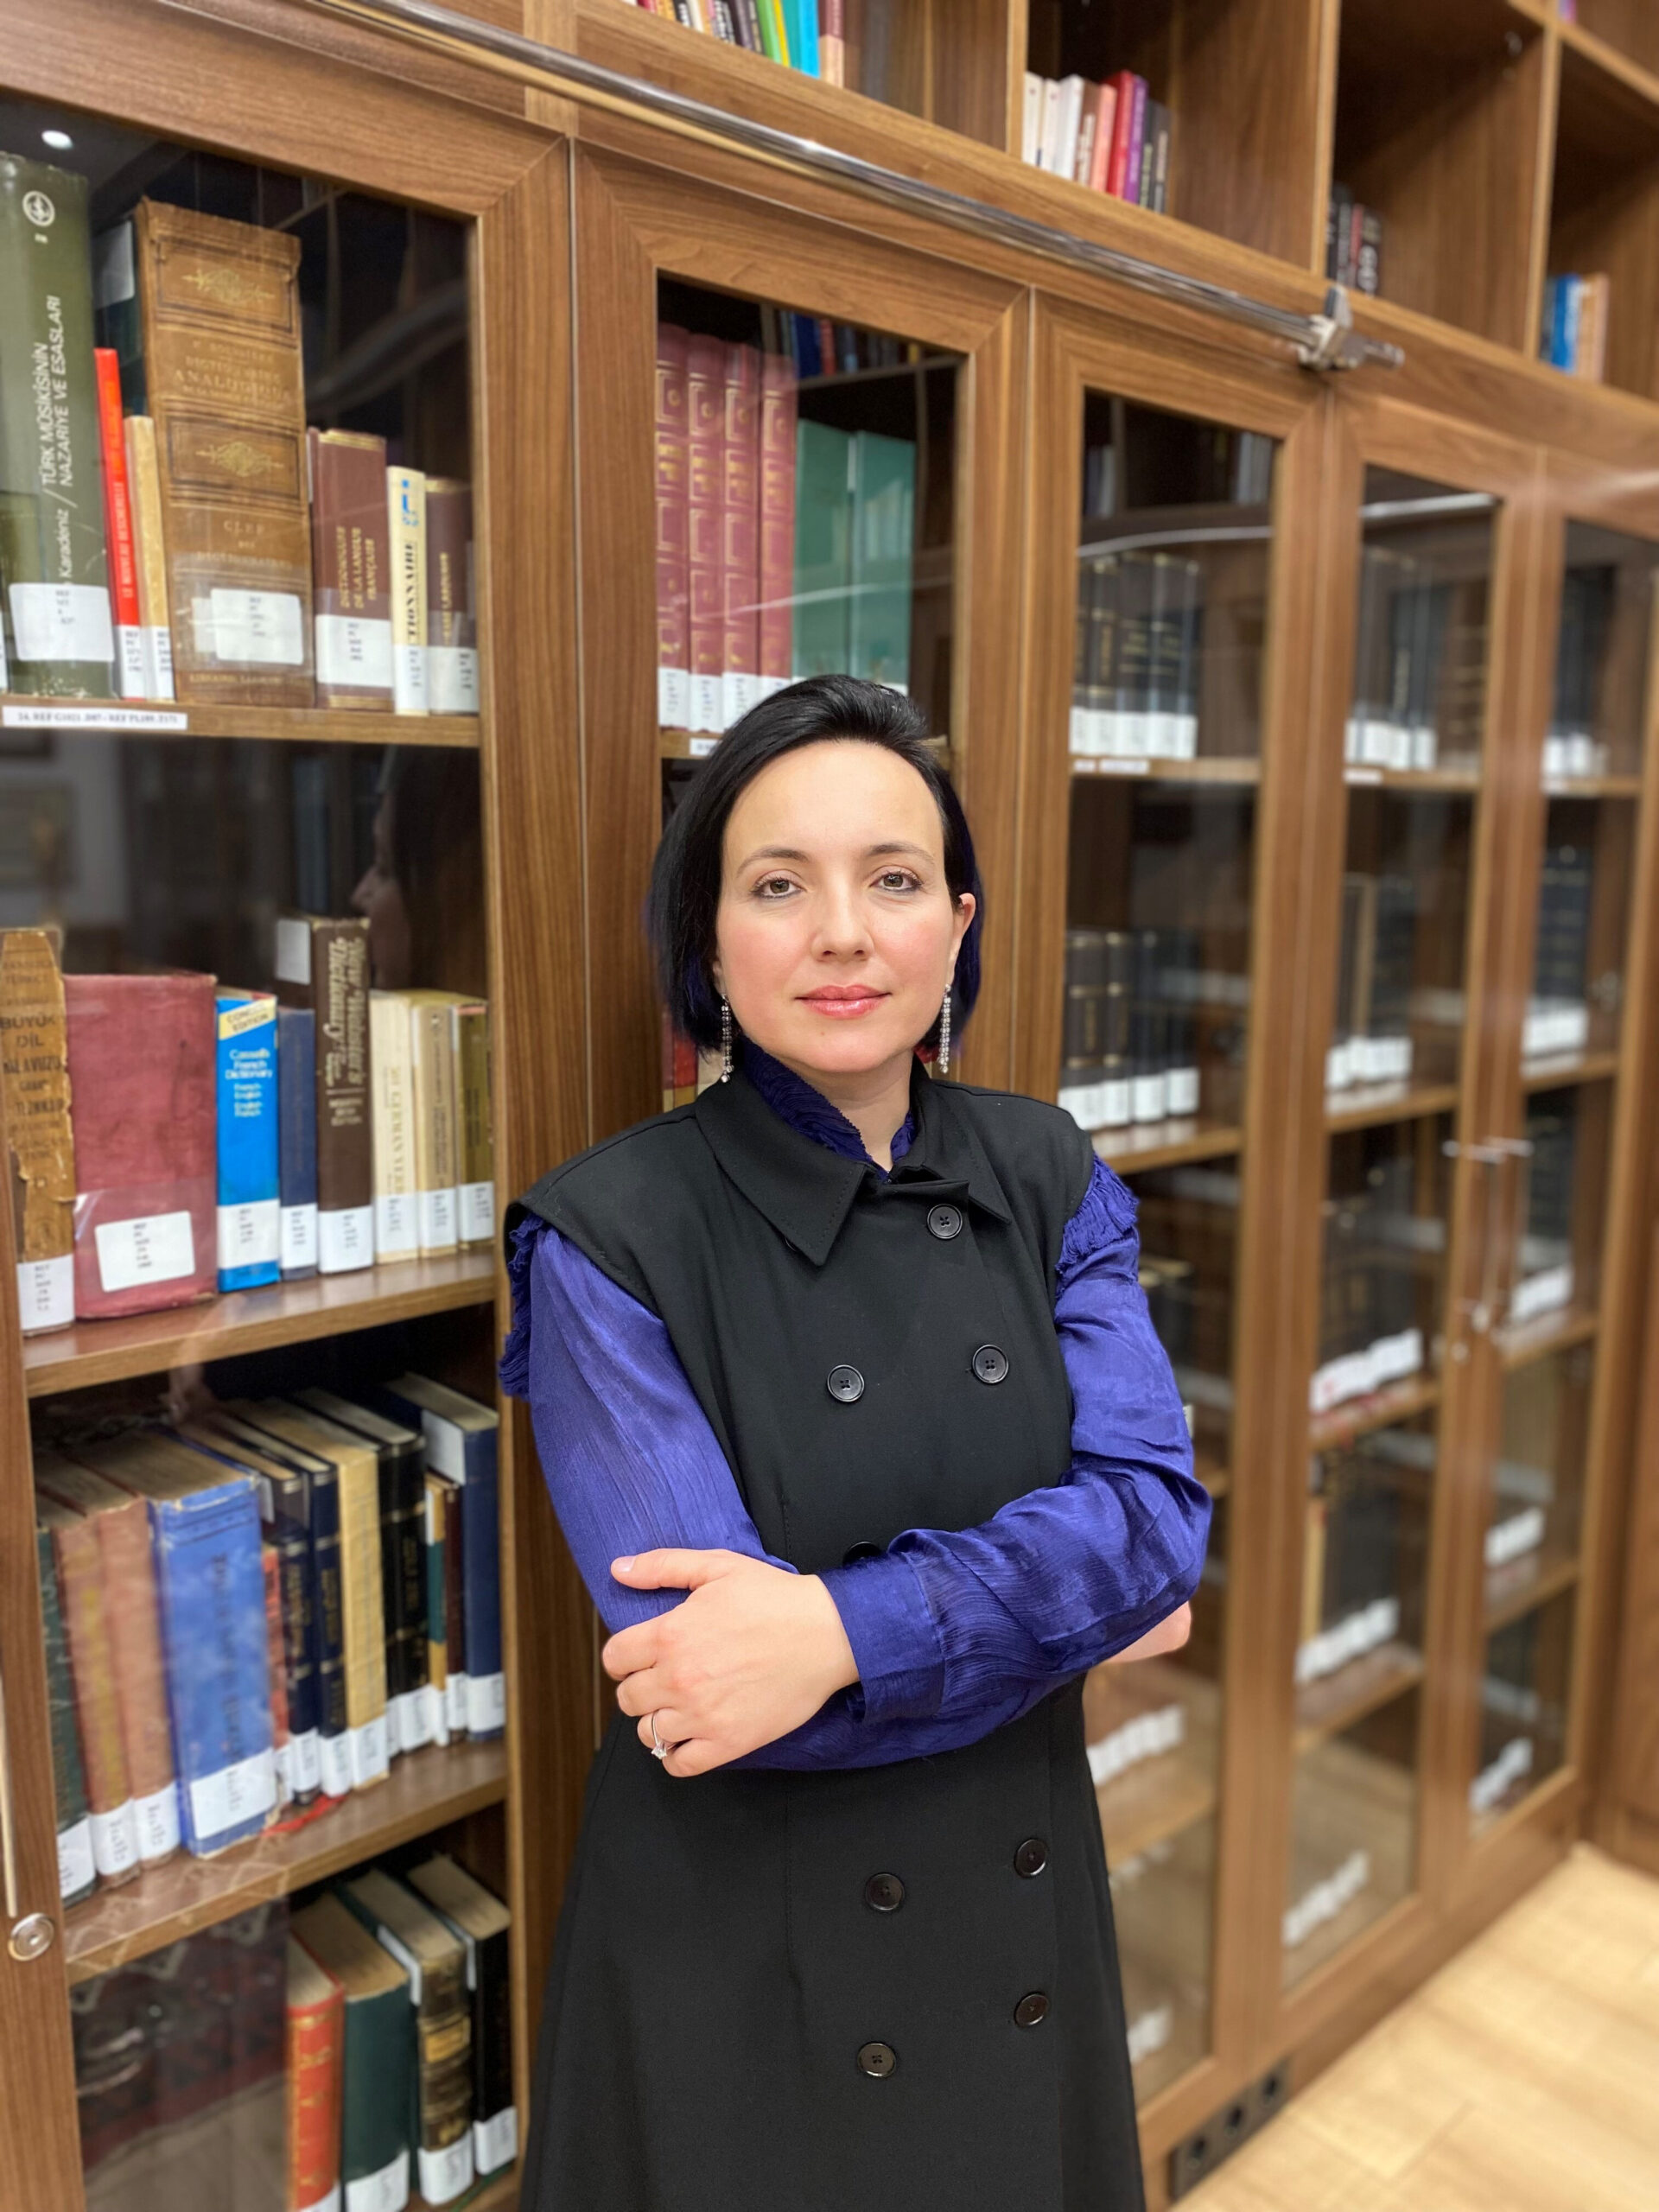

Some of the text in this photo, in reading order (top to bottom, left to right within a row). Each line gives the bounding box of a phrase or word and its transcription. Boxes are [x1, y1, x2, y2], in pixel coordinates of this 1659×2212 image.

[46, 295, 73, 486] NAZARİYE VE ESASLARI
[38, 446, 57, 485] TÜRK
[55, 508, 73, 579] Karadeniz
[16, 1031, 43, 1048] DİL
